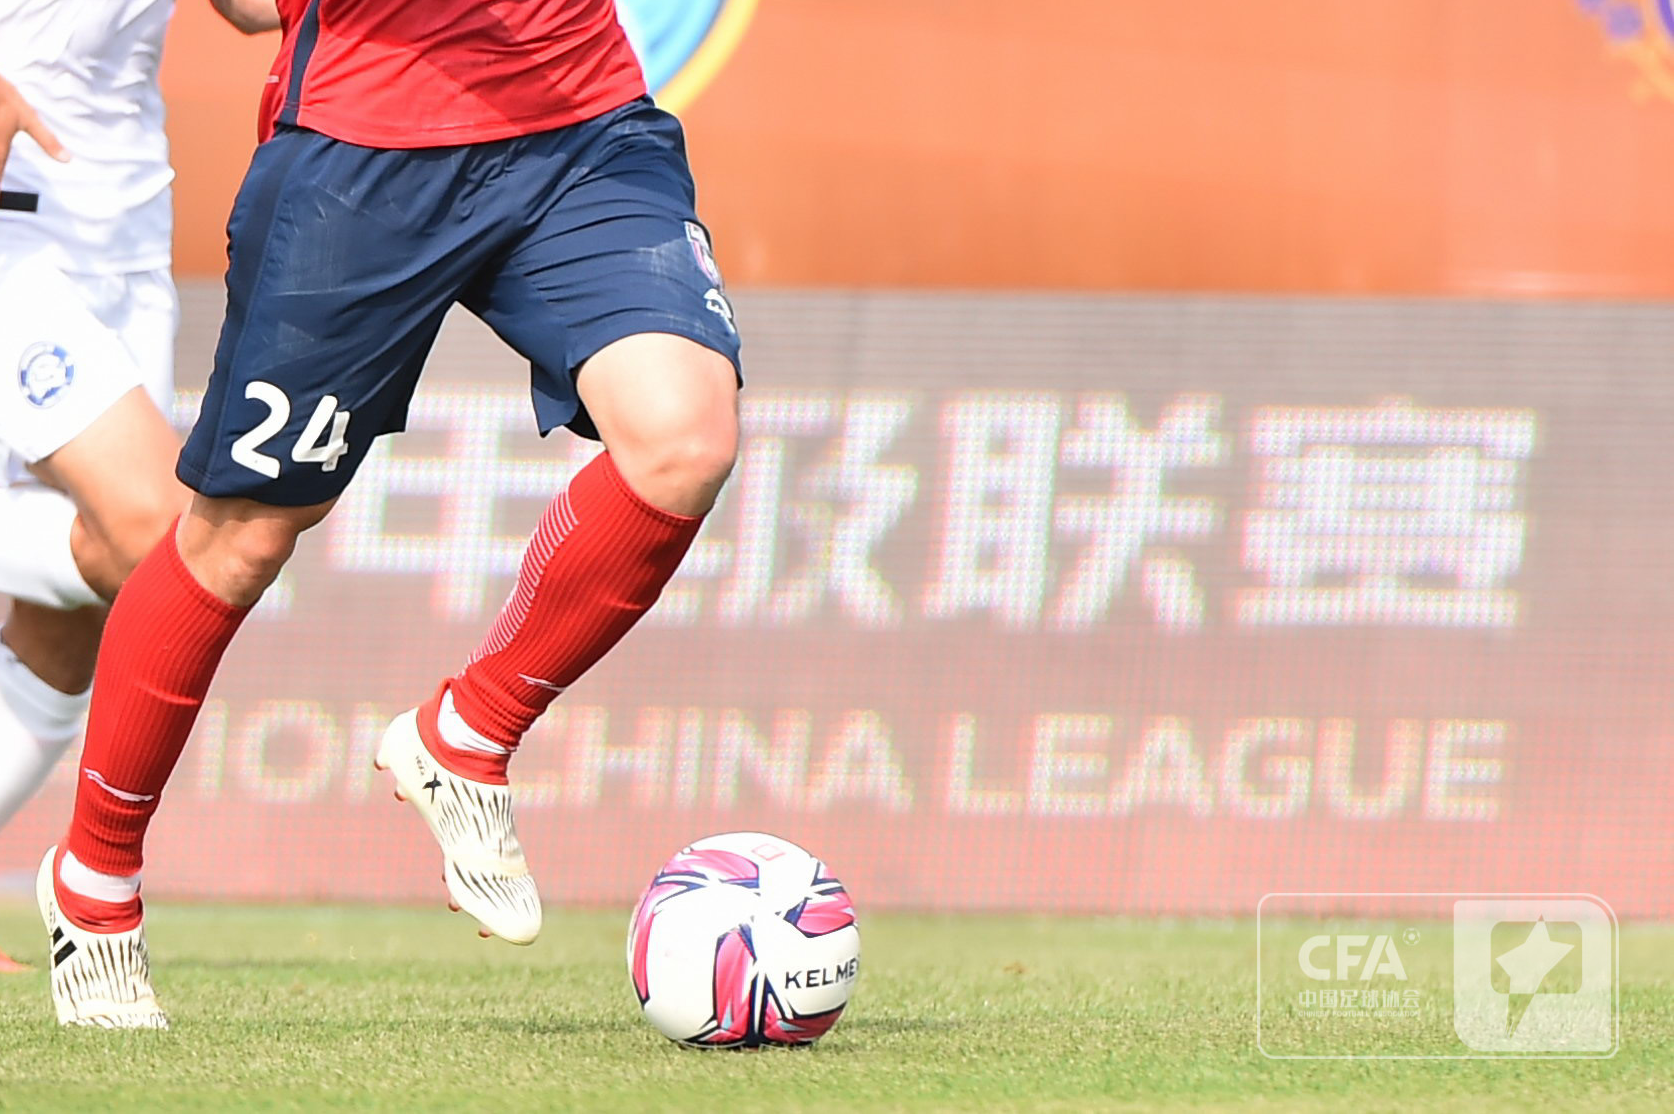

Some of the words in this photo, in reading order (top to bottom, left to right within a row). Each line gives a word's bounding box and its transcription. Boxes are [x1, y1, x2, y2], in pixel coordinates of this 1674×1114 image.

[230, 381, 352, 480] 24
[942, 713, 1516, 822] LEAGUE
[784, 957, 857, 989] KELME
